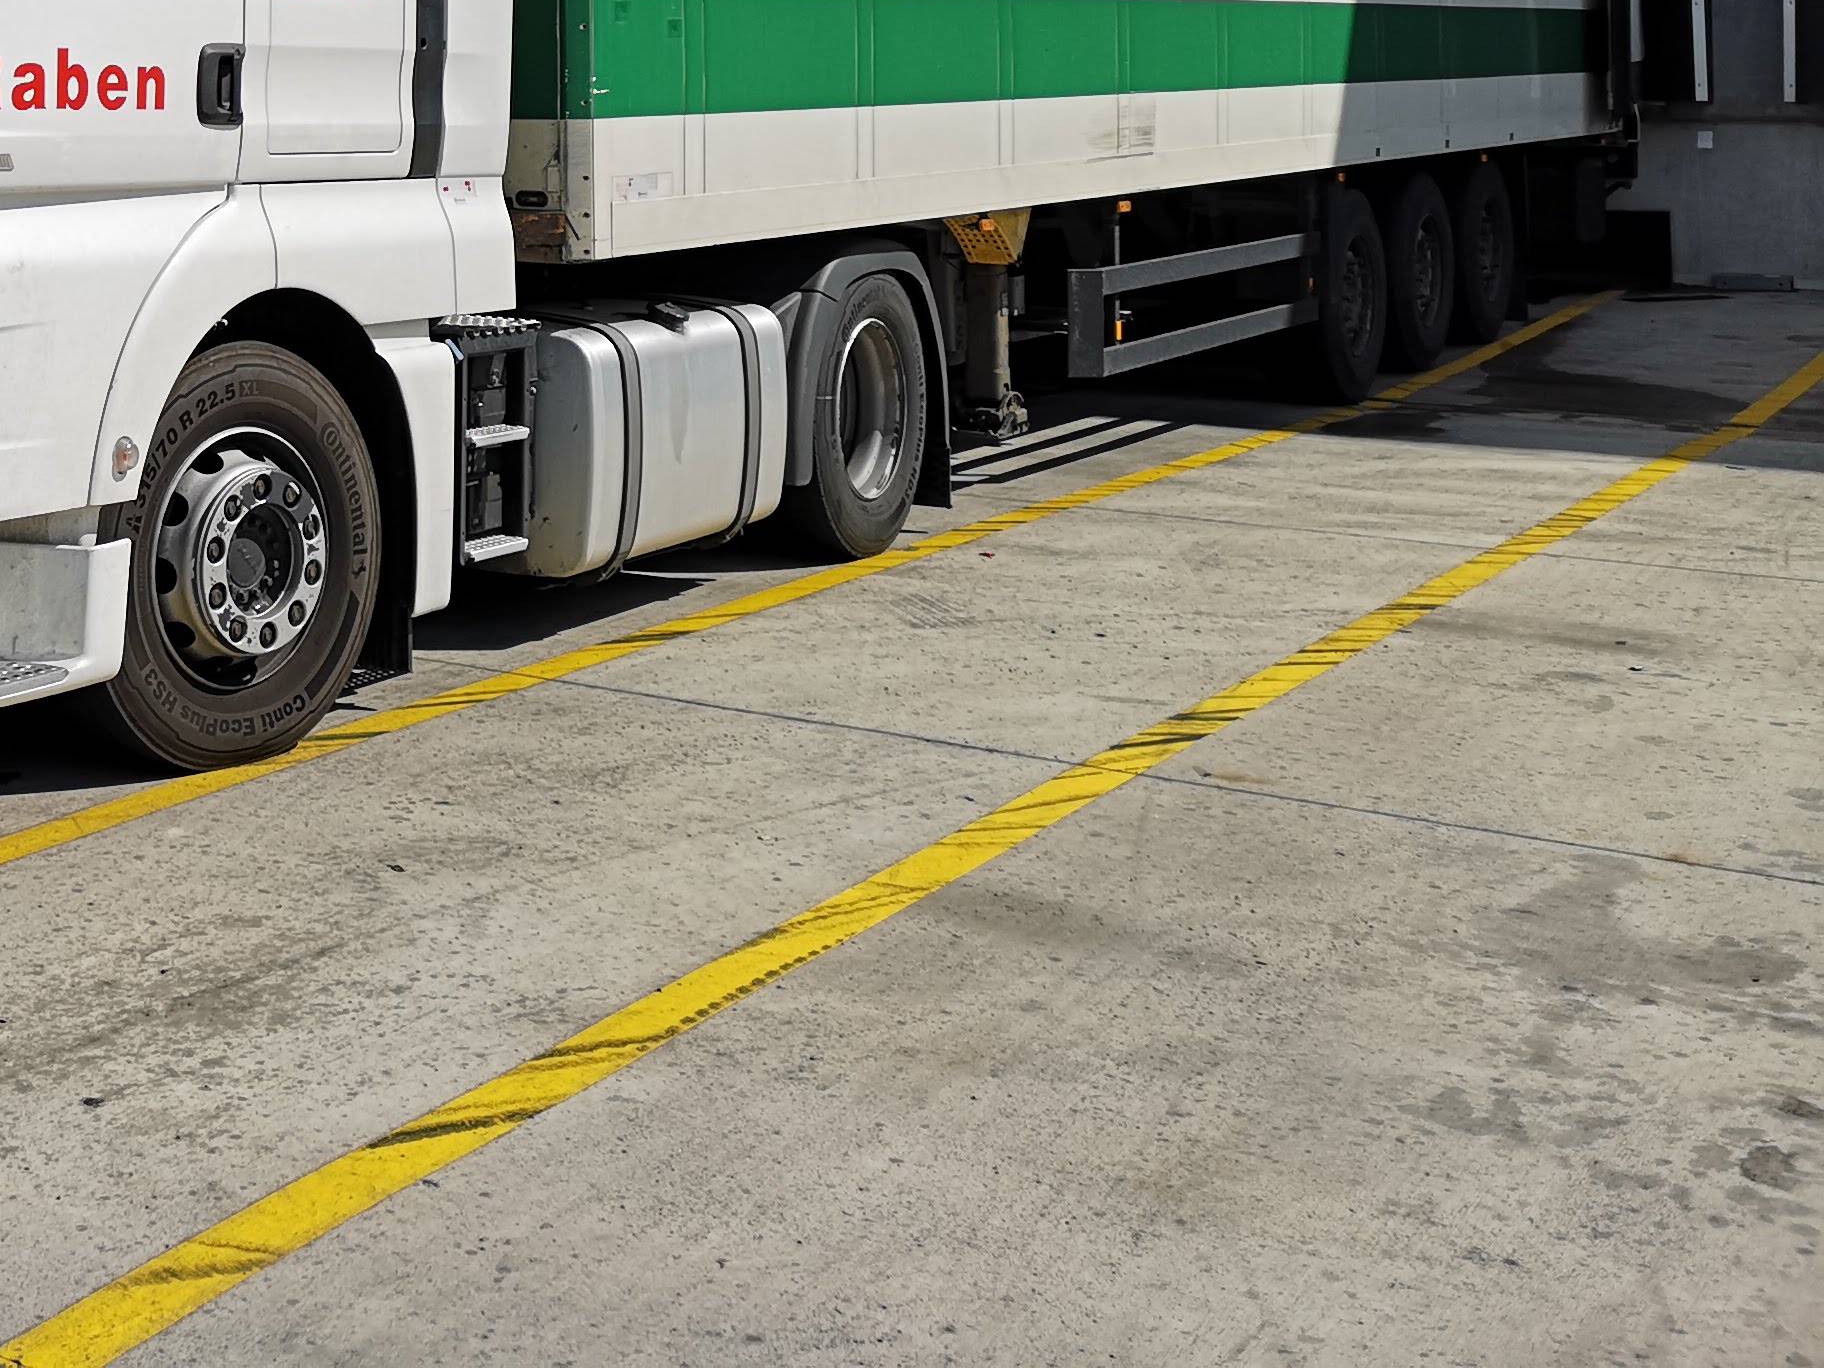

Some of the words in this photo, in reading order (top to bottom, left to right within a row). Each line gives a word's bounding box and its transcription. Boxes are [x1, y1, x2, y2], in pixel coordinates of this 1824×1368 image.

[179, 409, 195, 431] R
[195, 382, 237, 419] 22.5
[238, 381, 261, 398] XL
[321, 421, 369, 556] Continental
[143, 667, 177, 714] HS3
[260, 694, 307, 733] Conti
[179, 704, 257, 738] EcoPlus
